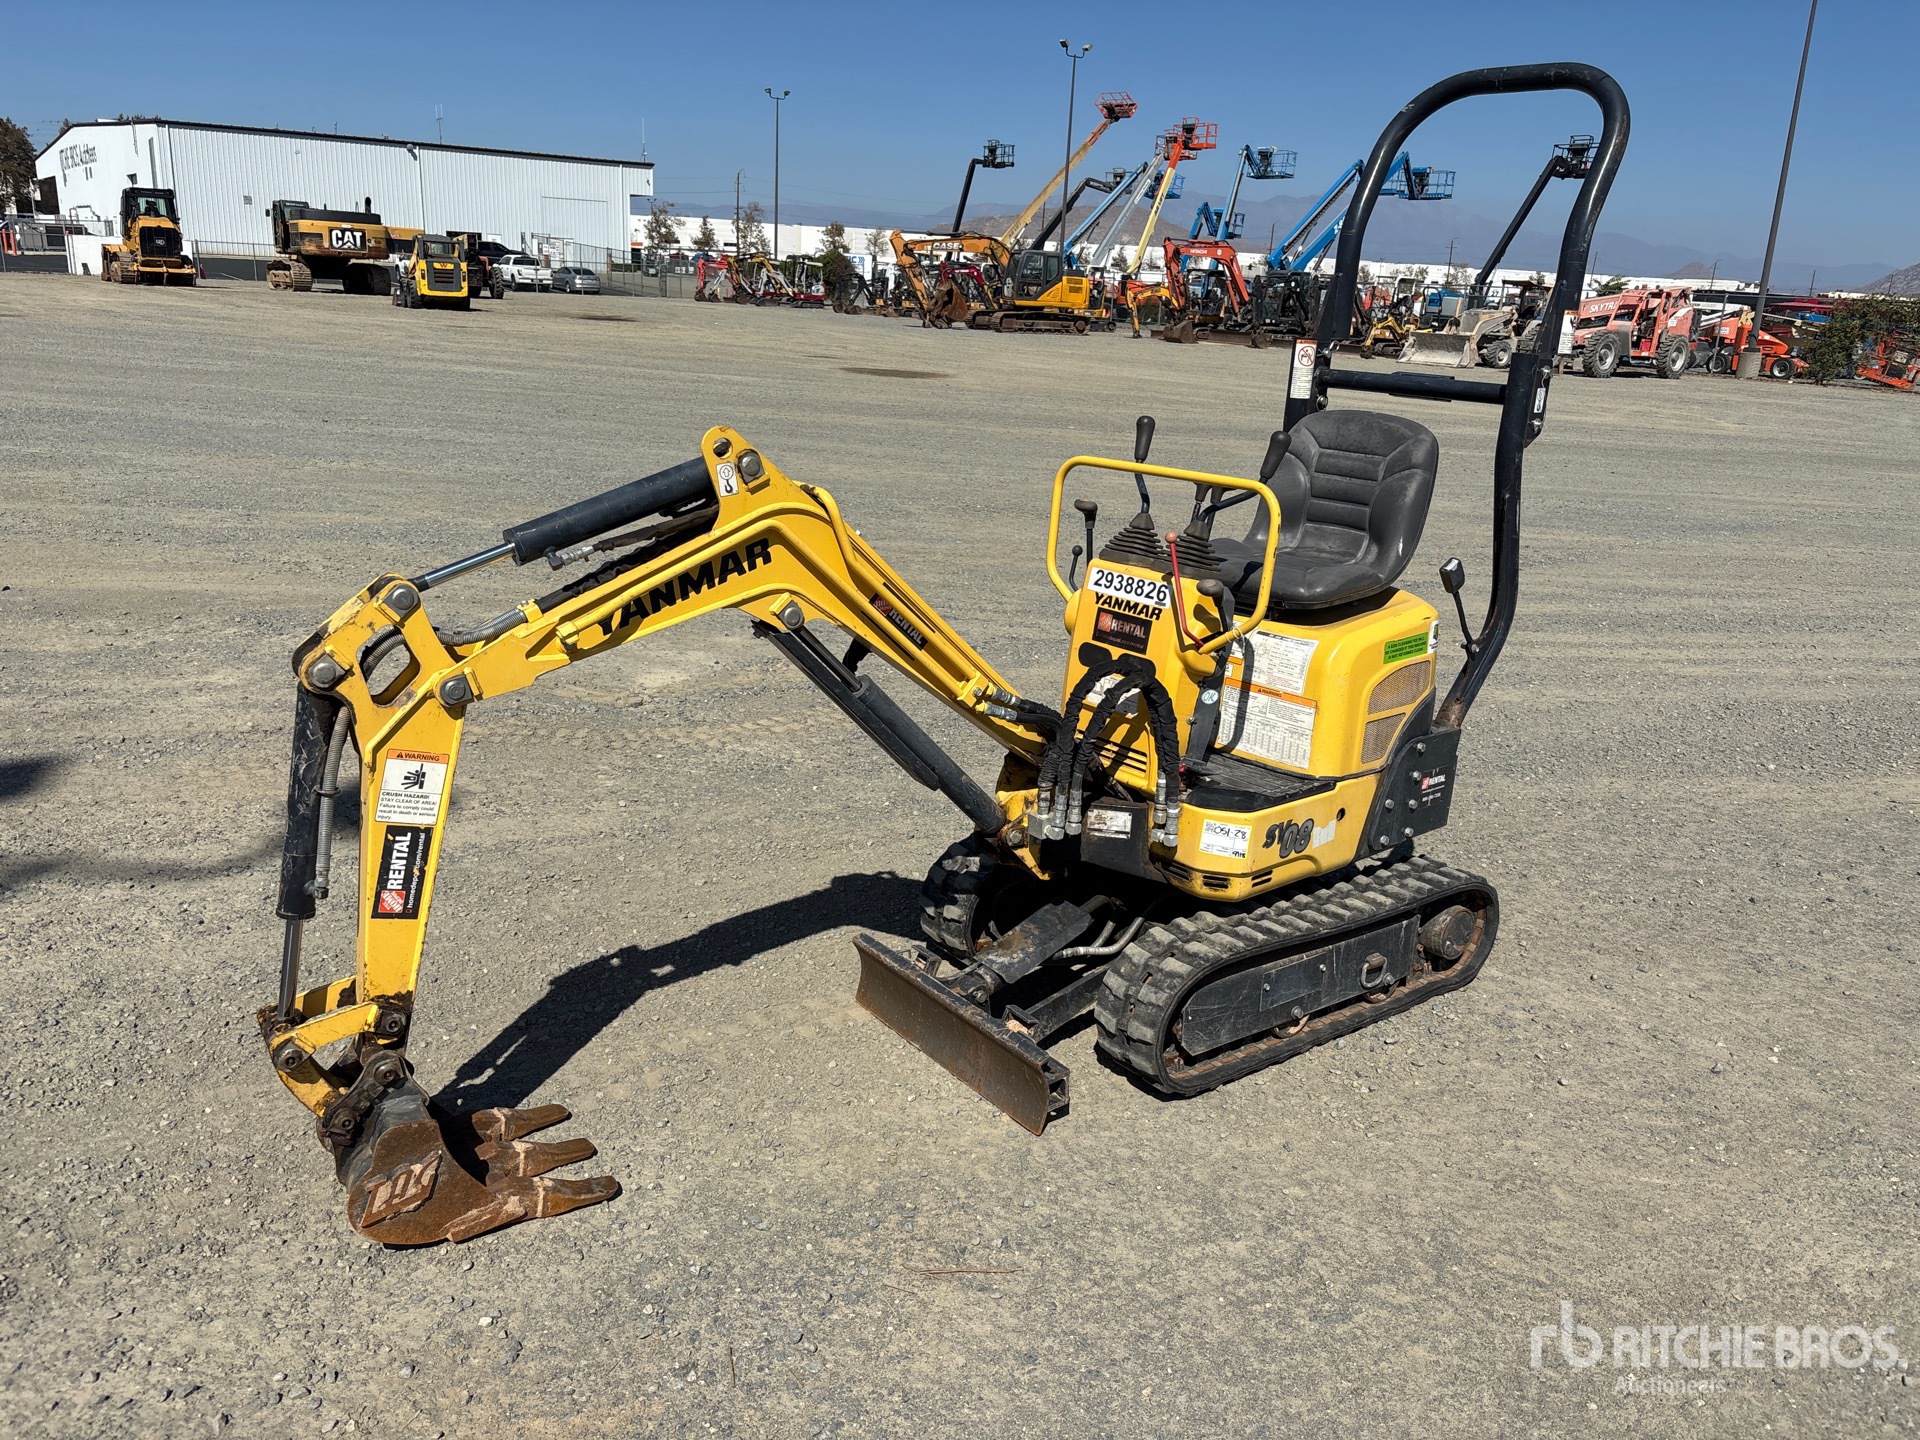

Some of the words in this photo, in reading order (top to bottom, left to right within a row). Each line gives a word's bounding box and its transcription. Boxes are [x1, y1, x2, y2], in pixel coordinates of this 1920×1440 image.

[331, 229, 363, 250] CAT
[932, 241, 961, 250] CASE
[596, 537, 773, 637] YANMAR
[1093, 569, 1169, 602] 2938826
[1094, 591, 1163, 621] YANMAR
[888, 608, 923, 645] RENTAL
[1111, 618, 1146, 639] RENTAL
[1204, 691, 1216, 702] OK
[404, 752, 440, 762] WARNING
[1428, 773, 1446, 786] RENTAL
[387, 832, 412, 890] RENTAL
[406, 832, 426, 909] homedepocom/rental
[381, 889, 402, 912] HOME
